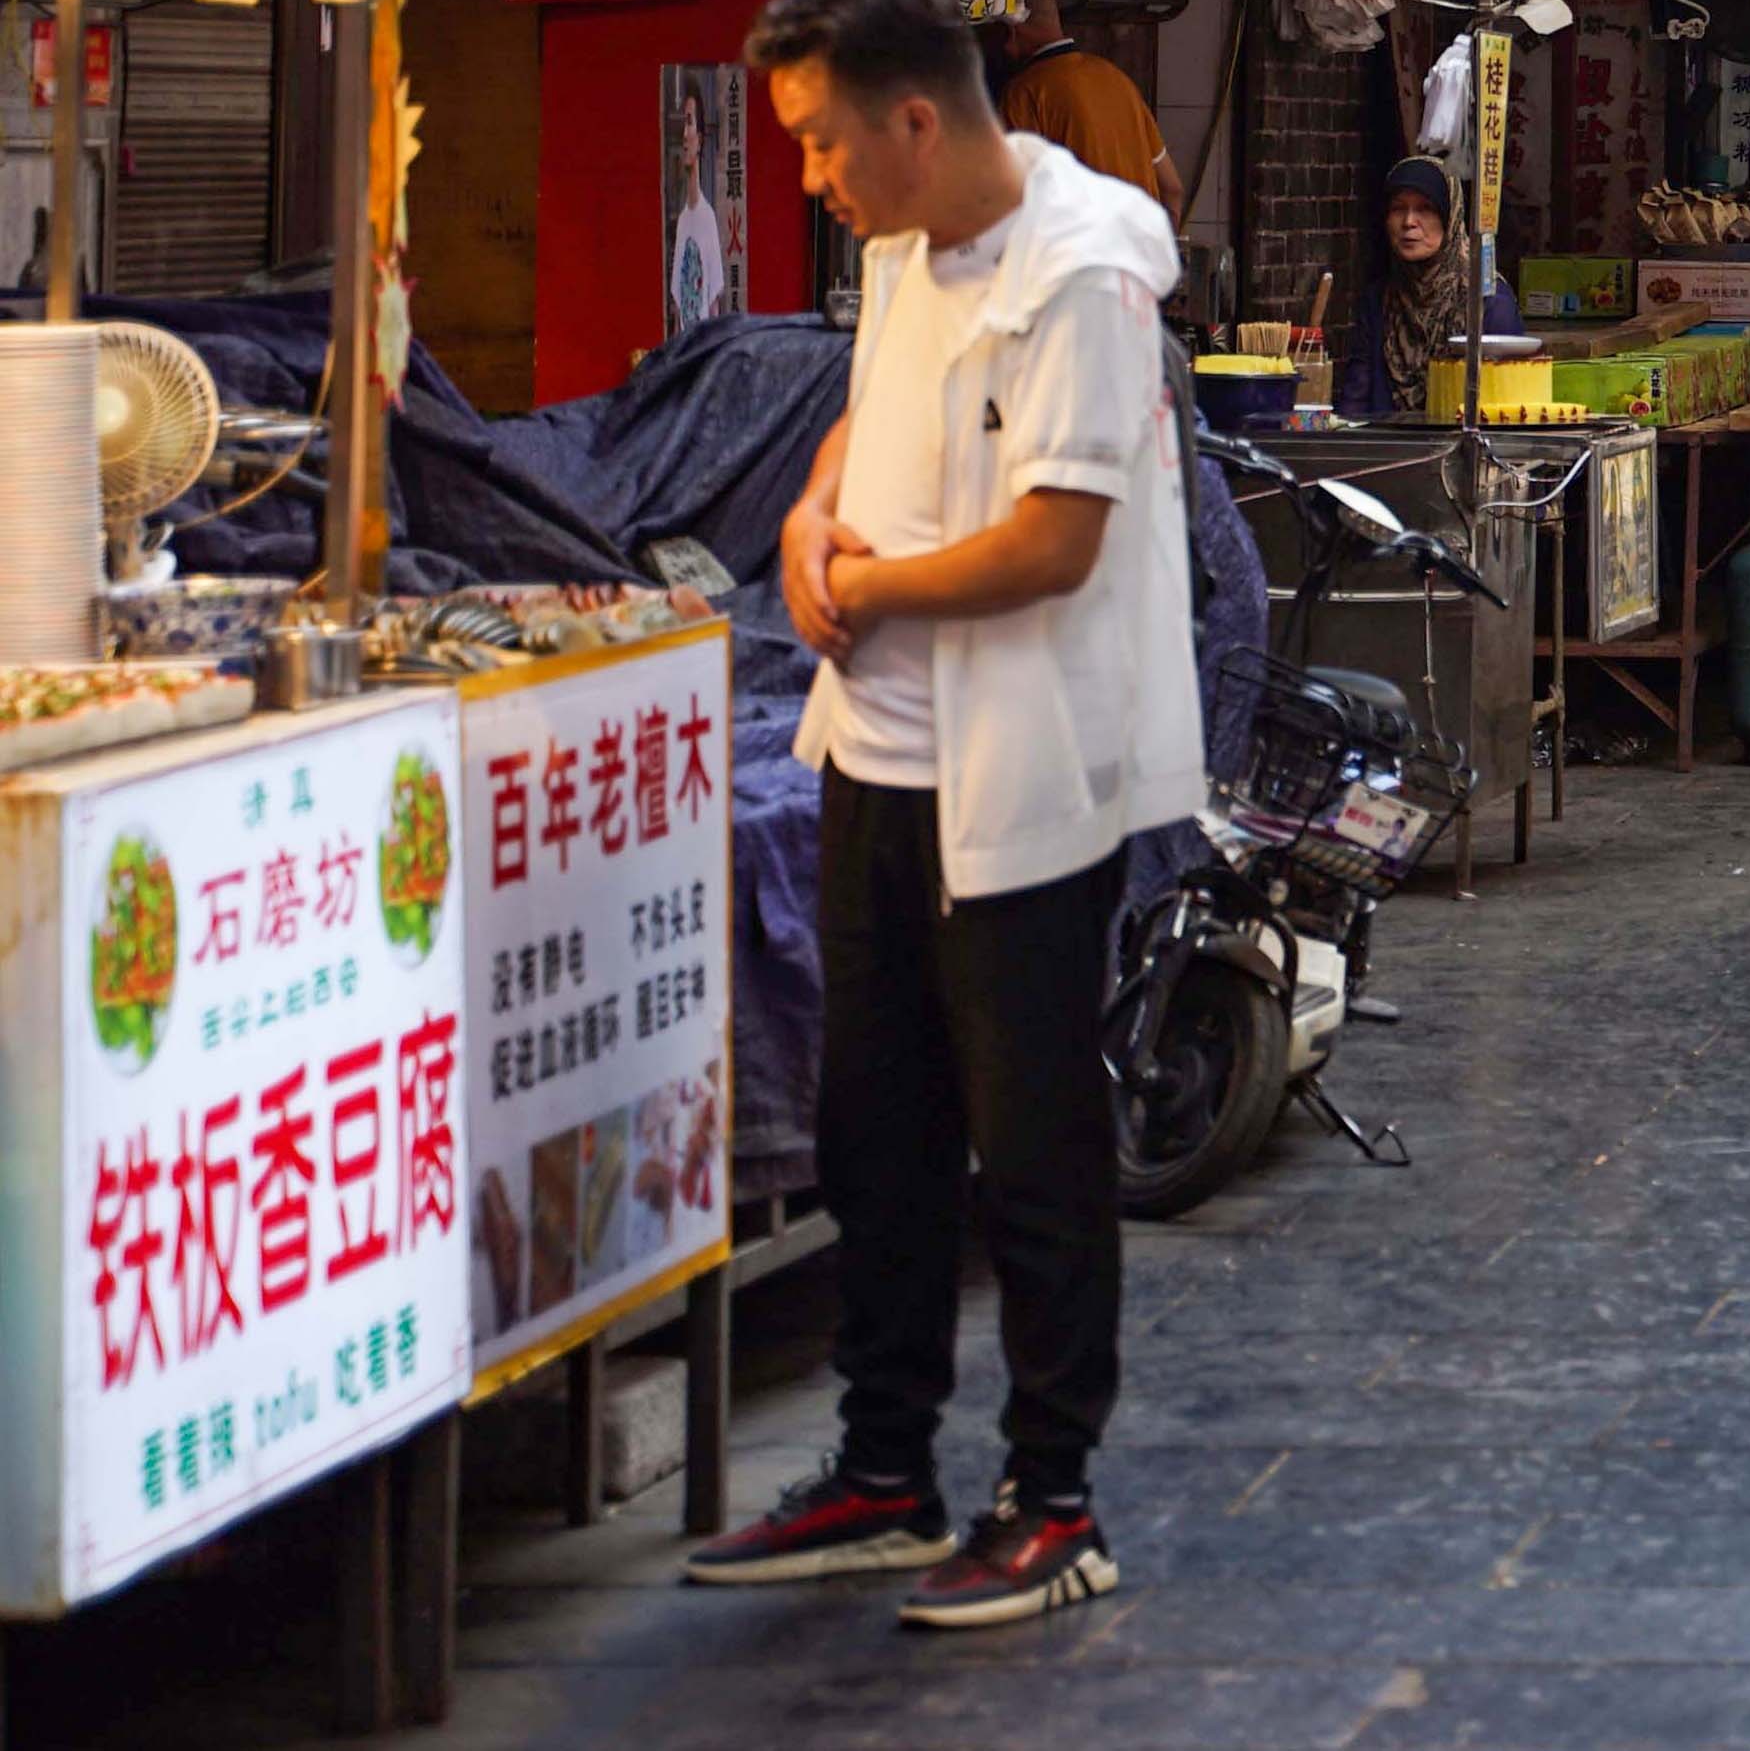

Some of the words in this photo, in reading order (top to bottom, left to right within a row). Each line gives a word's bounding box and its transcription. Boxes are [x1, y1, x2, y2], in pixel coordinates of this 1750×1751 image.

[487, 692, 712, 891] 百年老檀木
[193, 827, 363, 966] 石磨坊
[87, 1009, 457, 1391] 铁板香豆腐
